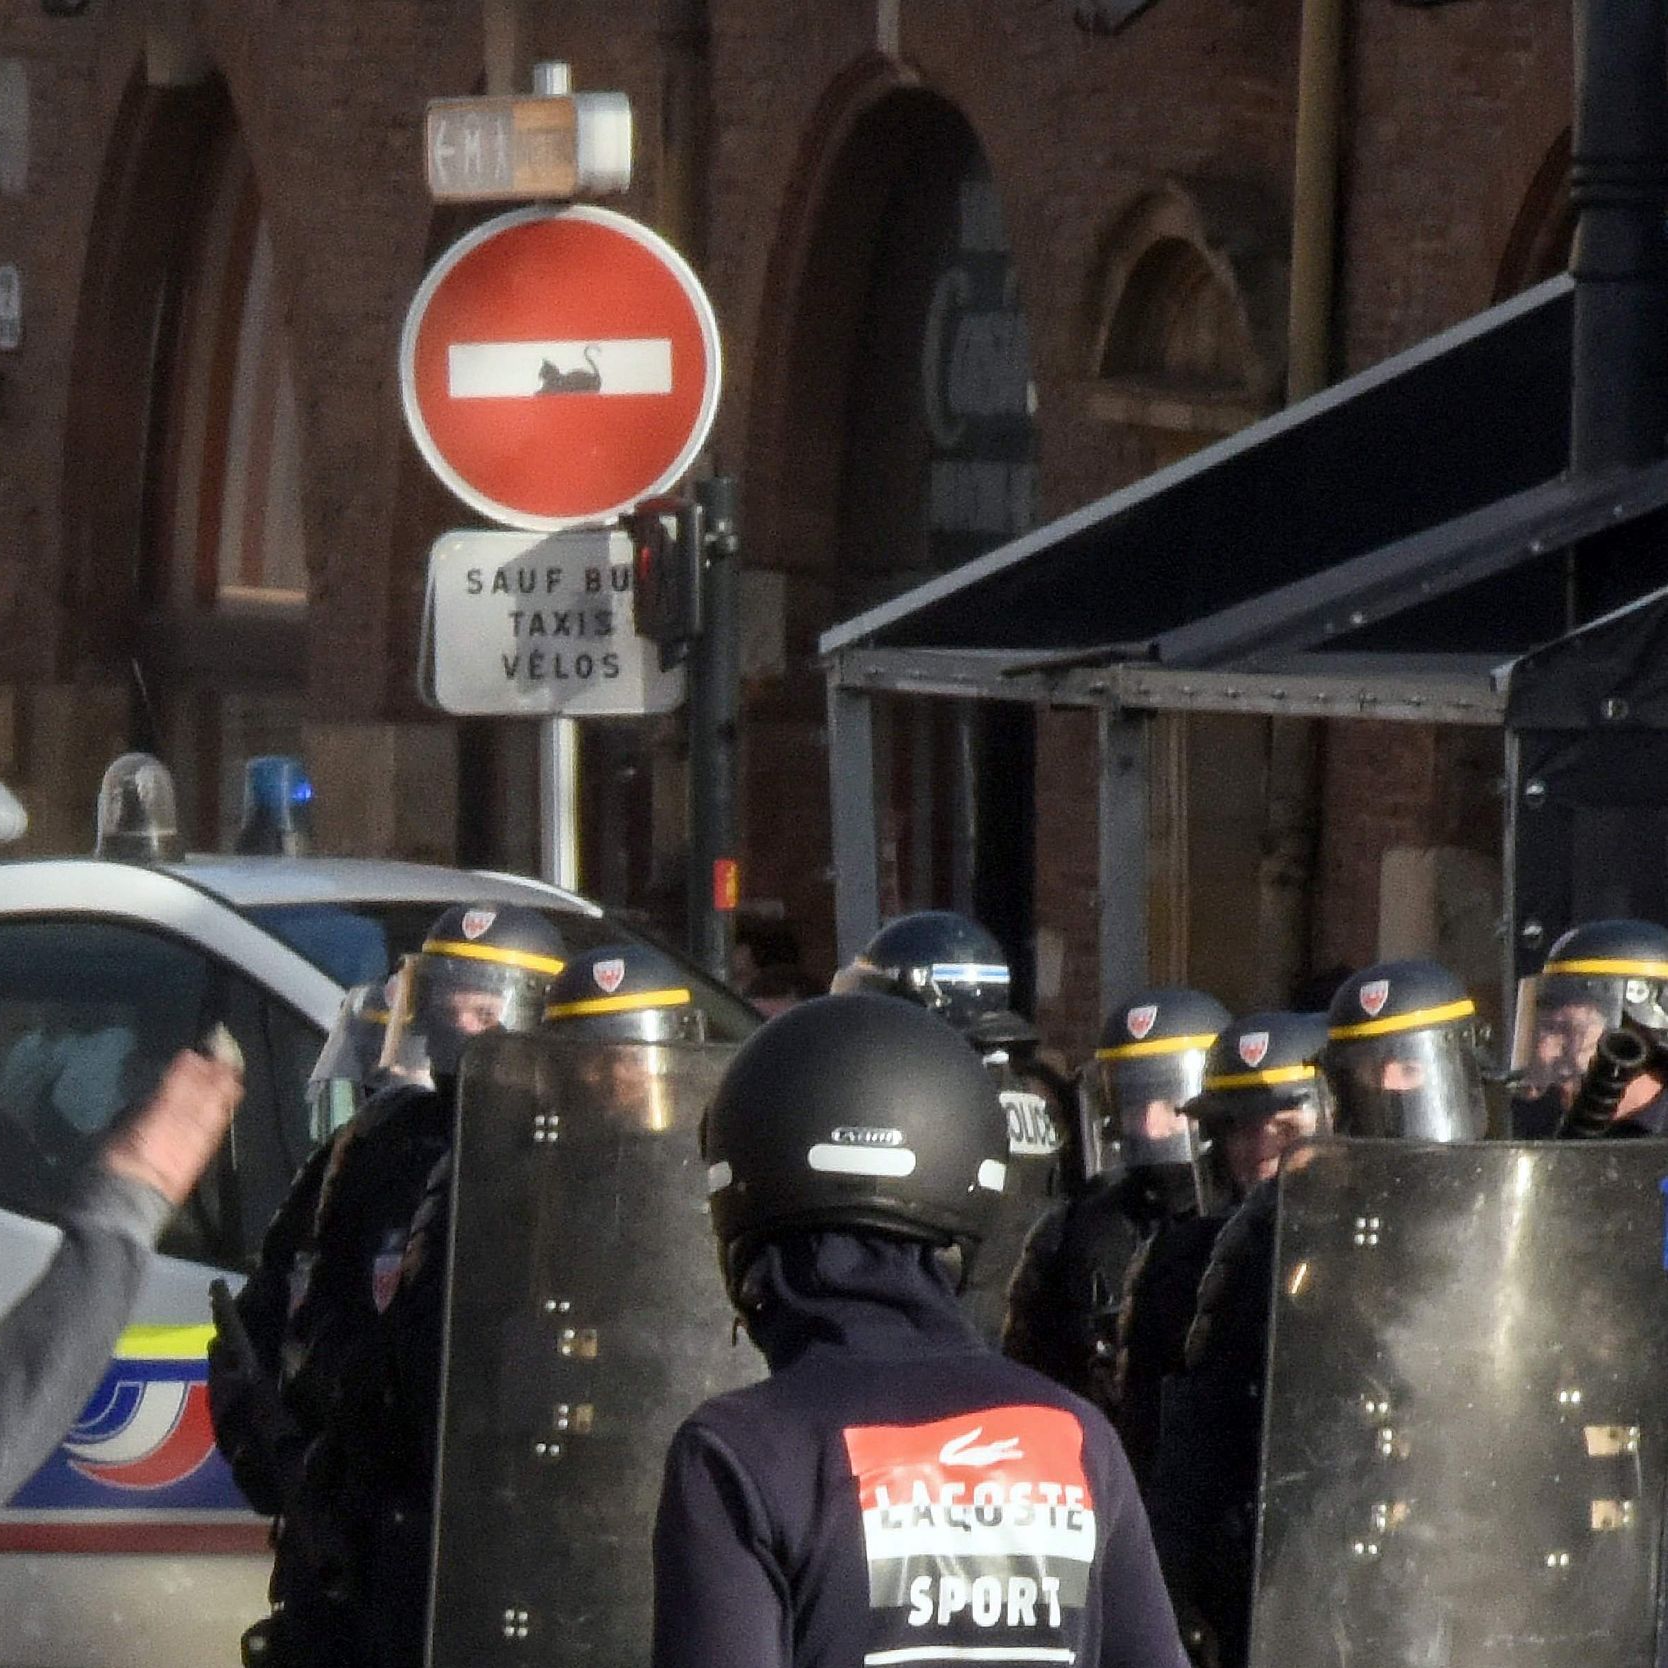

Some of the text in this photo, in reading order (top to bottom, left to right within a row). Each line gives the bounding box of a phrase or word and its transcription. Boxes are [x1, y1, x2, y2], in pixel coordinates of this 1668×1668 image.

[466, 567, 630, 594] SAUF BU
[509, 611, 614, 637] TAXIS
[502, 647, 620, 680] VÉLOS
[875, 1479, 1085, 1532] LACOSTE
[907, 1575, 1062, 1629] SPORT
